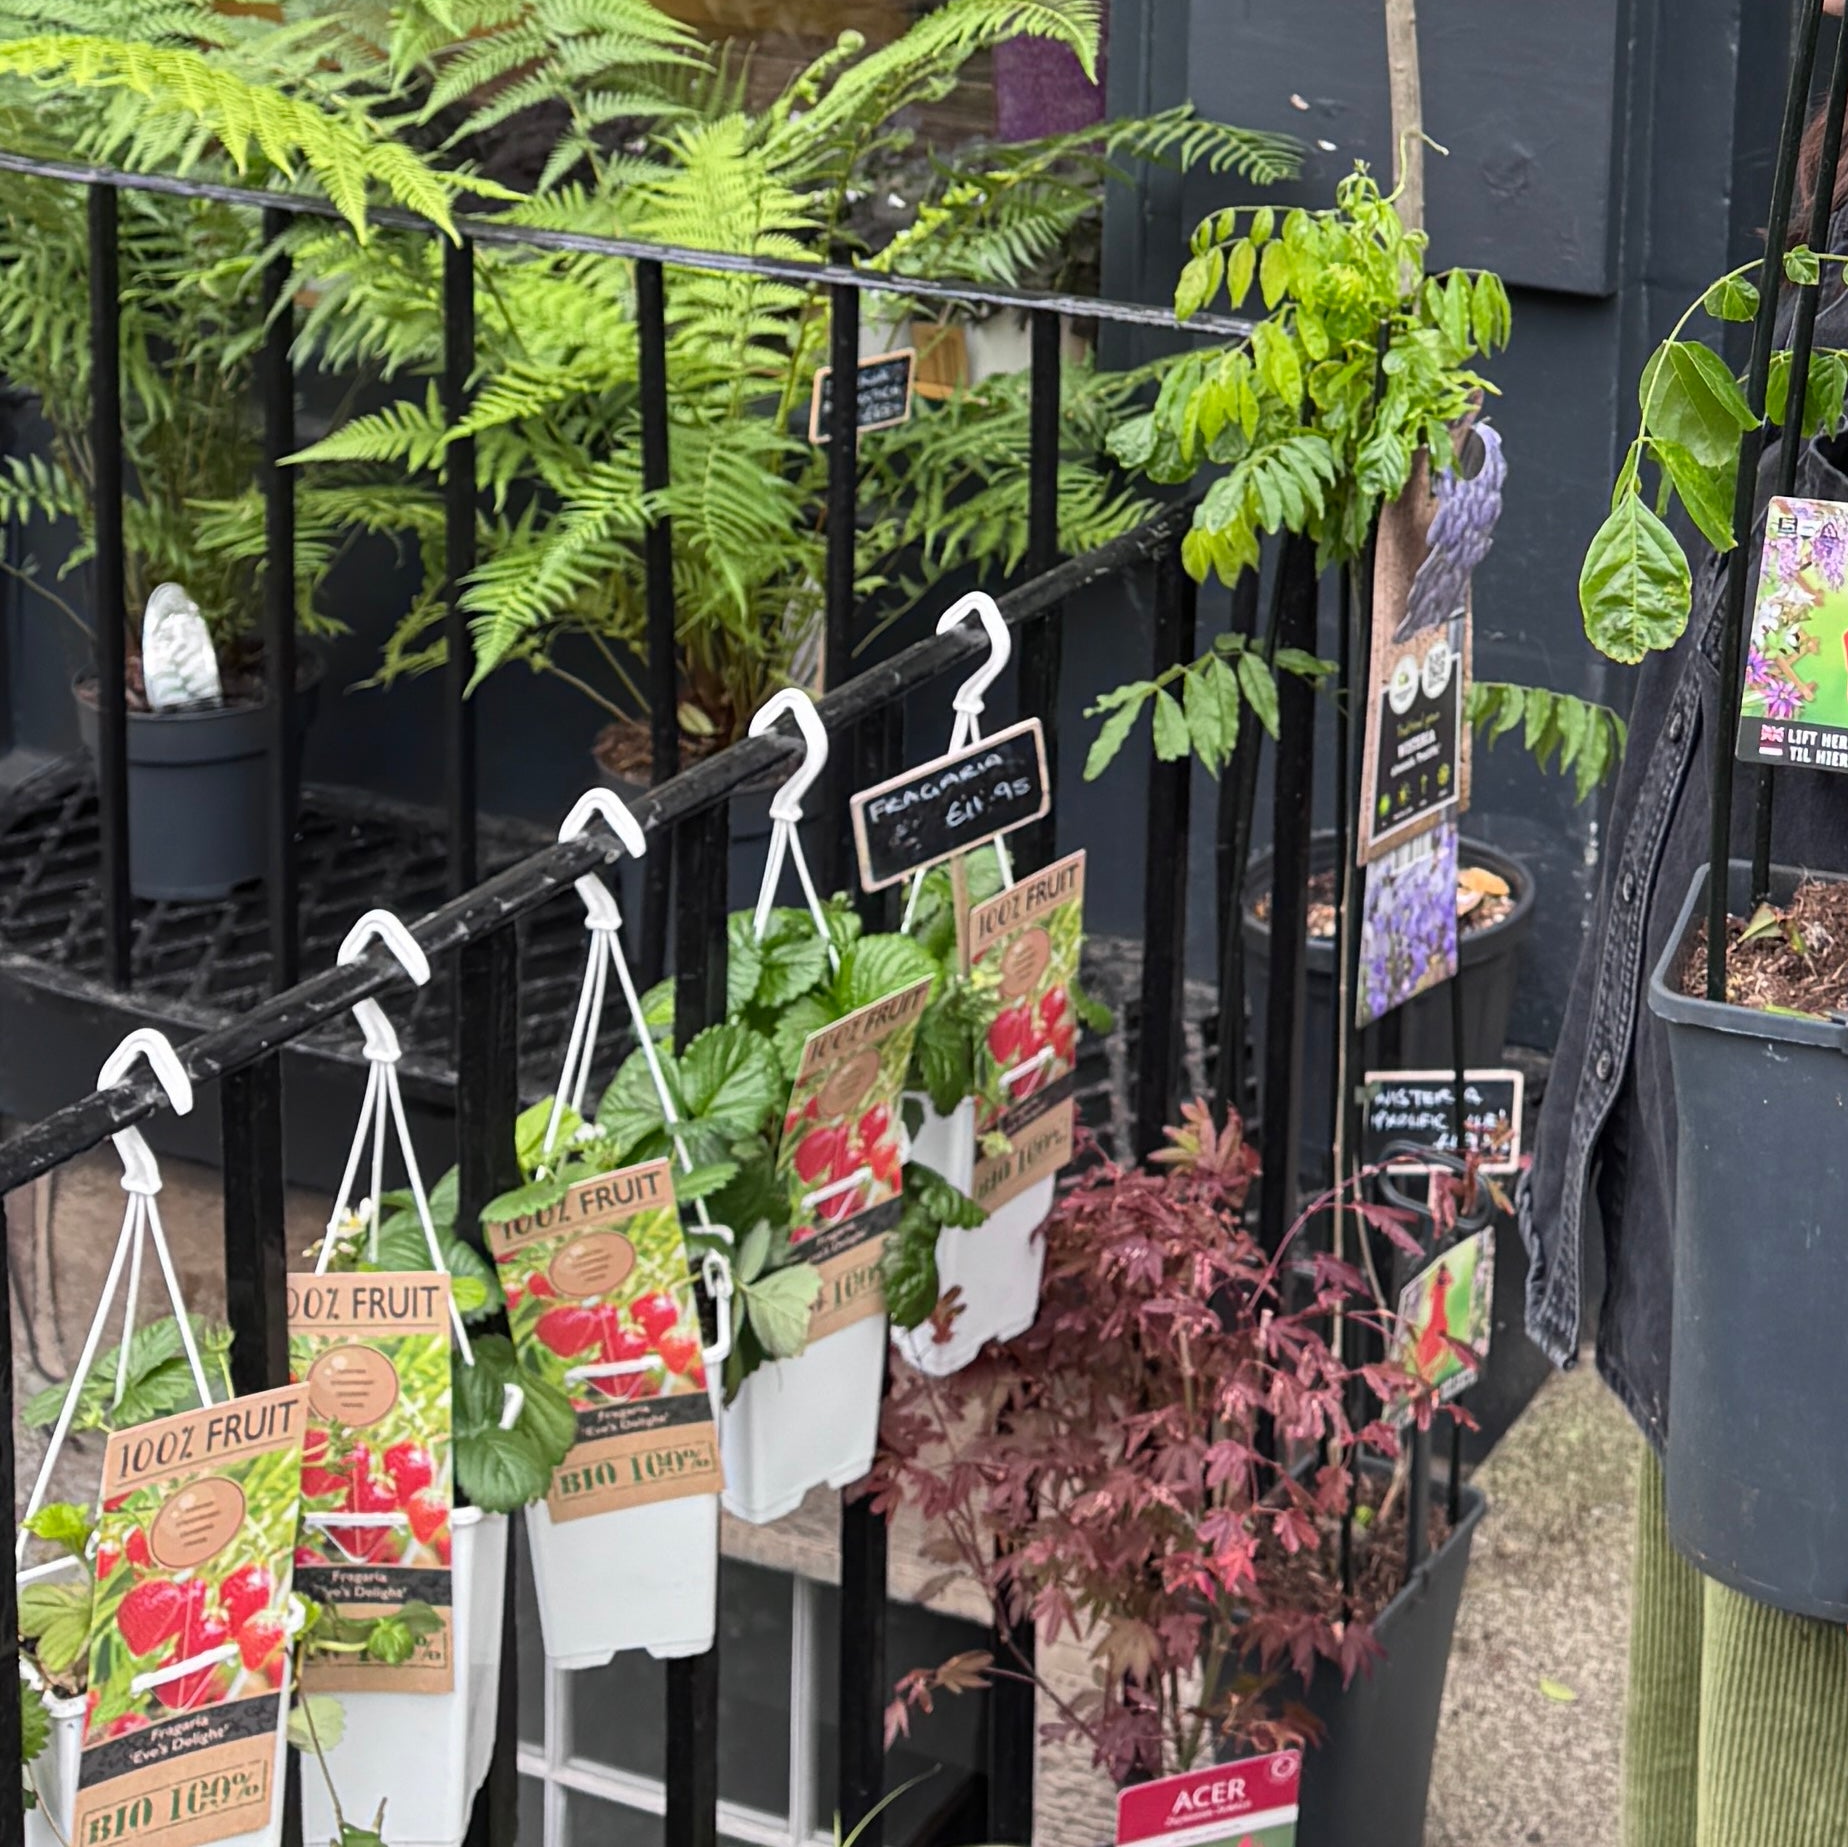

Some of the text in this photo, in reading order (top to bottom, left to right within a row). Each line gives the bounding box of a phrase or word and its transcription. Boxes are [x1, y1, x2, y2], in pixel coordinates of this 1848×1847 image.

[1787, 729, 1817, 746] LIFT
[1789, 746, 1811, 763] TIL
[1026, 862, 1079, 912] FRUIT
[579, 1170, 661, 1215] FRUIT
[287, 1286, 440, 1320] 00% FRUIT
[119, 1399, 299, 1479] 100% FRUIT
[560, 1459, 617, 1495] BIO
[150, 1715, 210, 1742] Fragaria
[88, 1771, 260, 1845] BIO 100%
[1171, 1778, 1247, 1816] ACER
